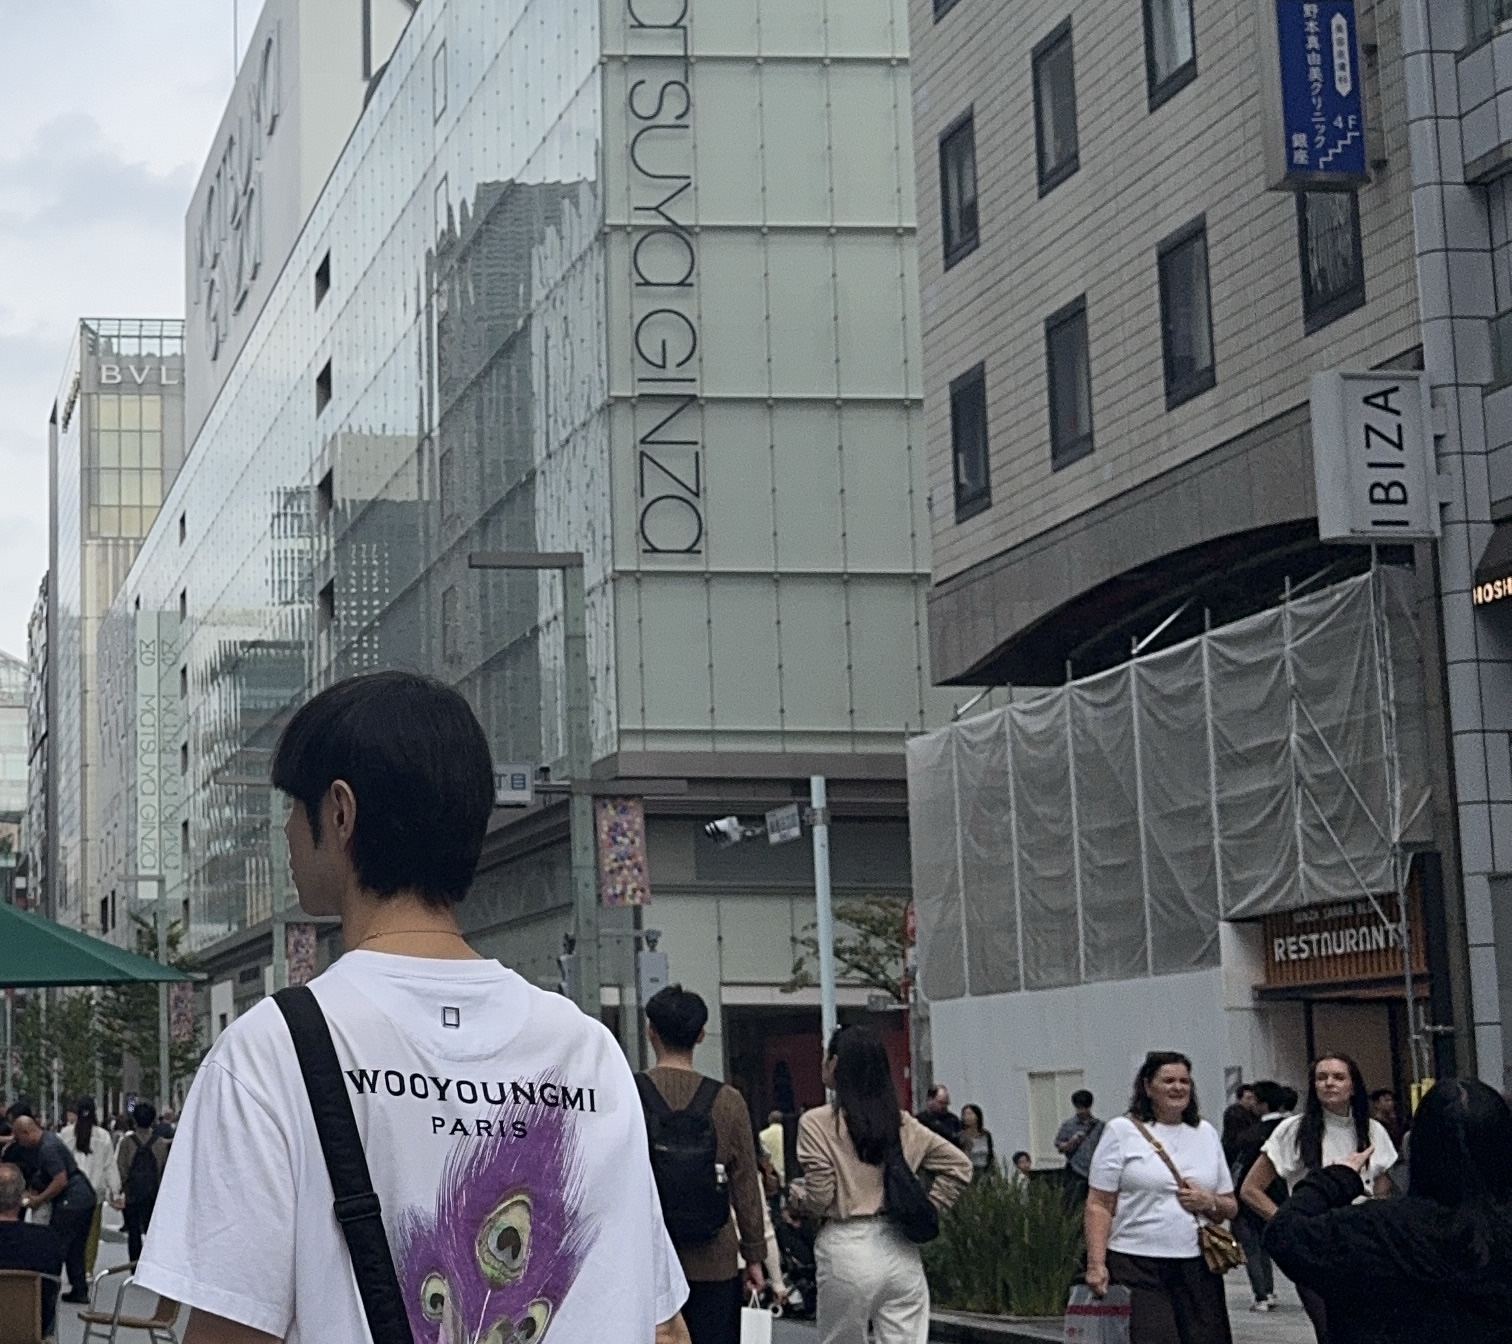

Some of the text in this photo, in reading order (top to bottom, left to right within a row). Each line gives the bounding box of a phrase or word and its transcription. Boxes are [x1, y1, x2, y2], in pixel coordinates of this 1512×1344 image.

[1364, 385, 1409, 527] IBIZA
[345, 1068, 597, 1113] WOOYOUNGMI
[431, 1116, 528, 1139] PARIS
